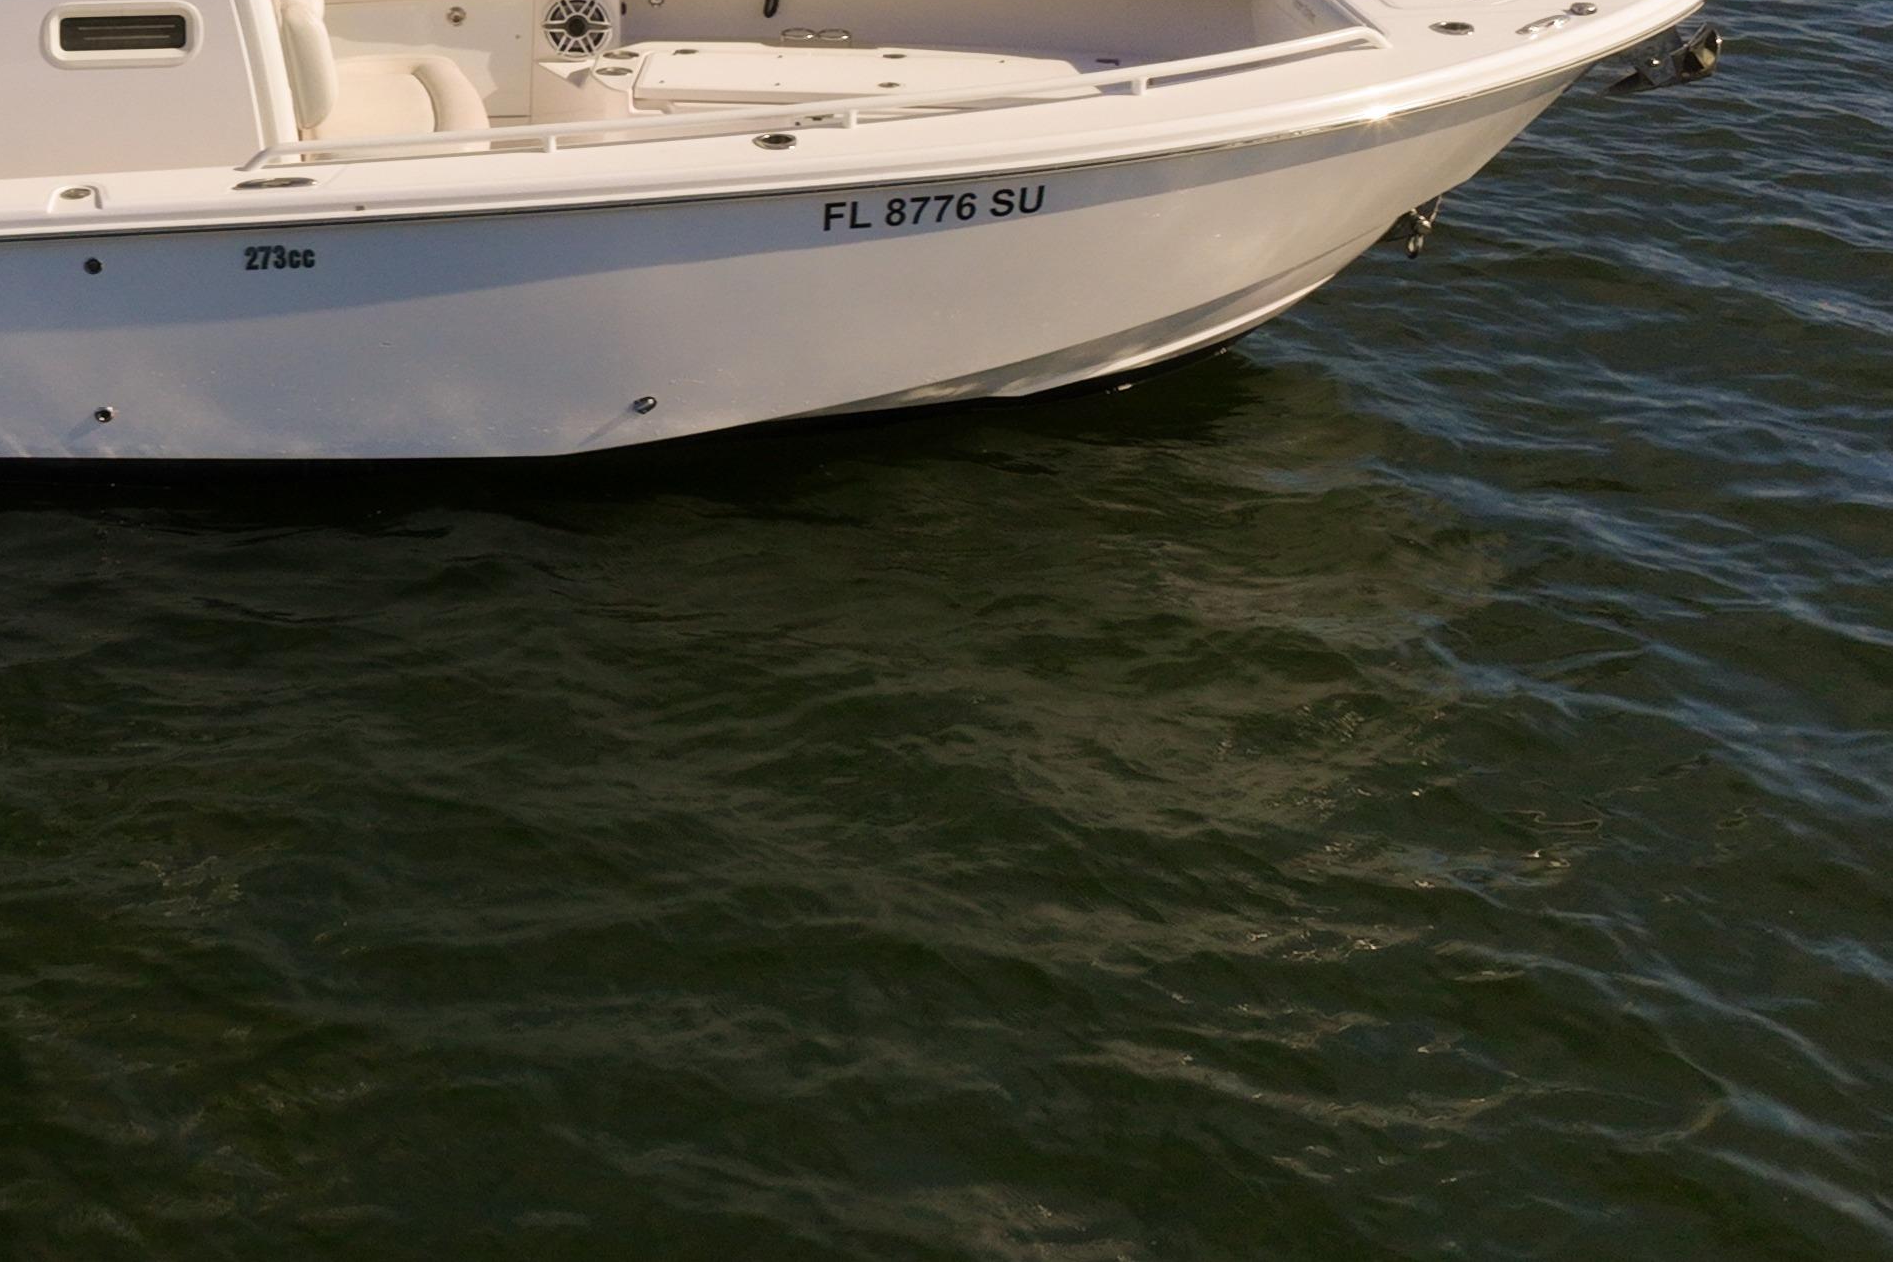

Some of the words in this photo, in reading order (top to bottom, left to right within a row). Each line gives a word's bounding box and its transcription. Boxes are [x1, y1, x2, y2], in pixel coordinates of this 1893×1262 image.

[823, 201, 872, 232] FL
[885, 192, 977, 227] 8776
[989, 185, 1046, 218] SU
[244, 244, 316, 271] 273cc
